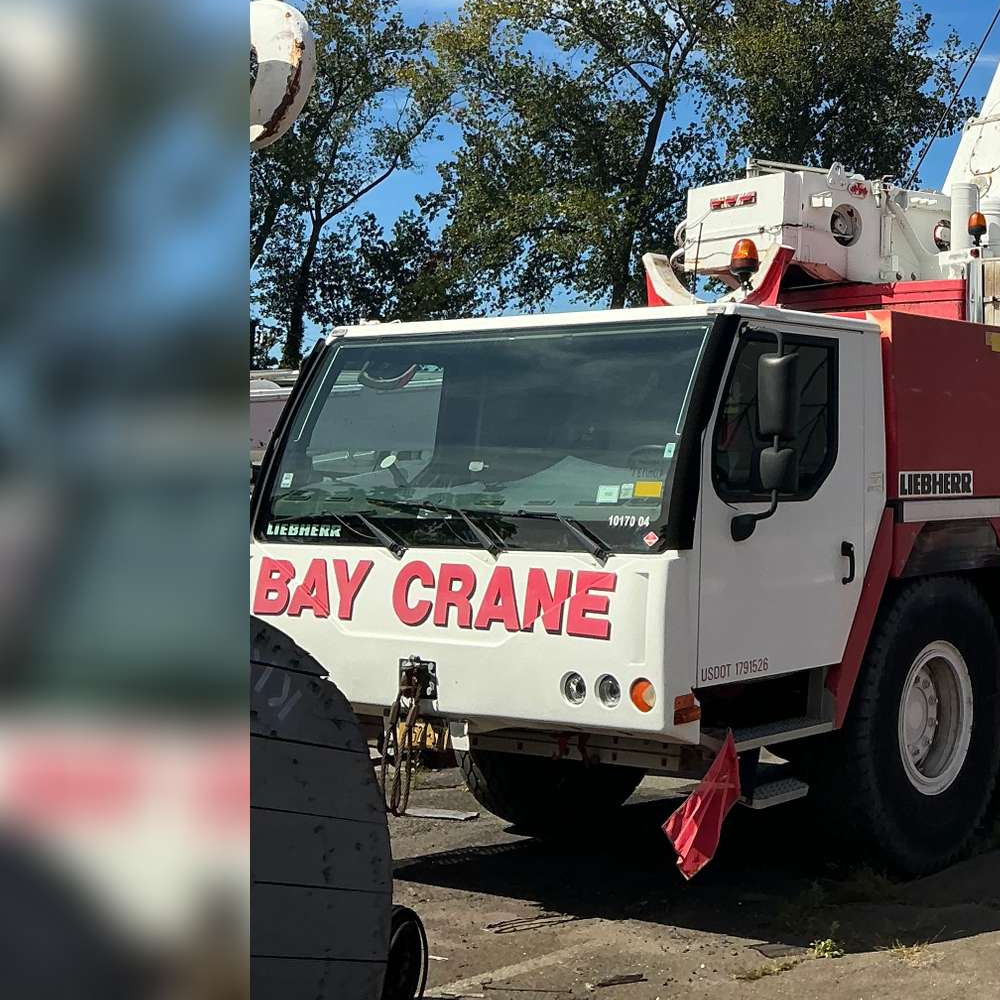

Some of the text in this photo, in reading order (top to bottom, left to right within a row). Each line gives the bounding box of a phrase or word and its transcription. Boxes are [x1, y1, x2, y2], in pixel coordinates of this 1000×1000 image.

[900, 473, 972, 496] LIEBHERR
[266, 521, 342, 538] LIEBHERR
[253, 556, 618, 641] BAY CRANE
[701, 657, 769, 682] USDOT 1791526
